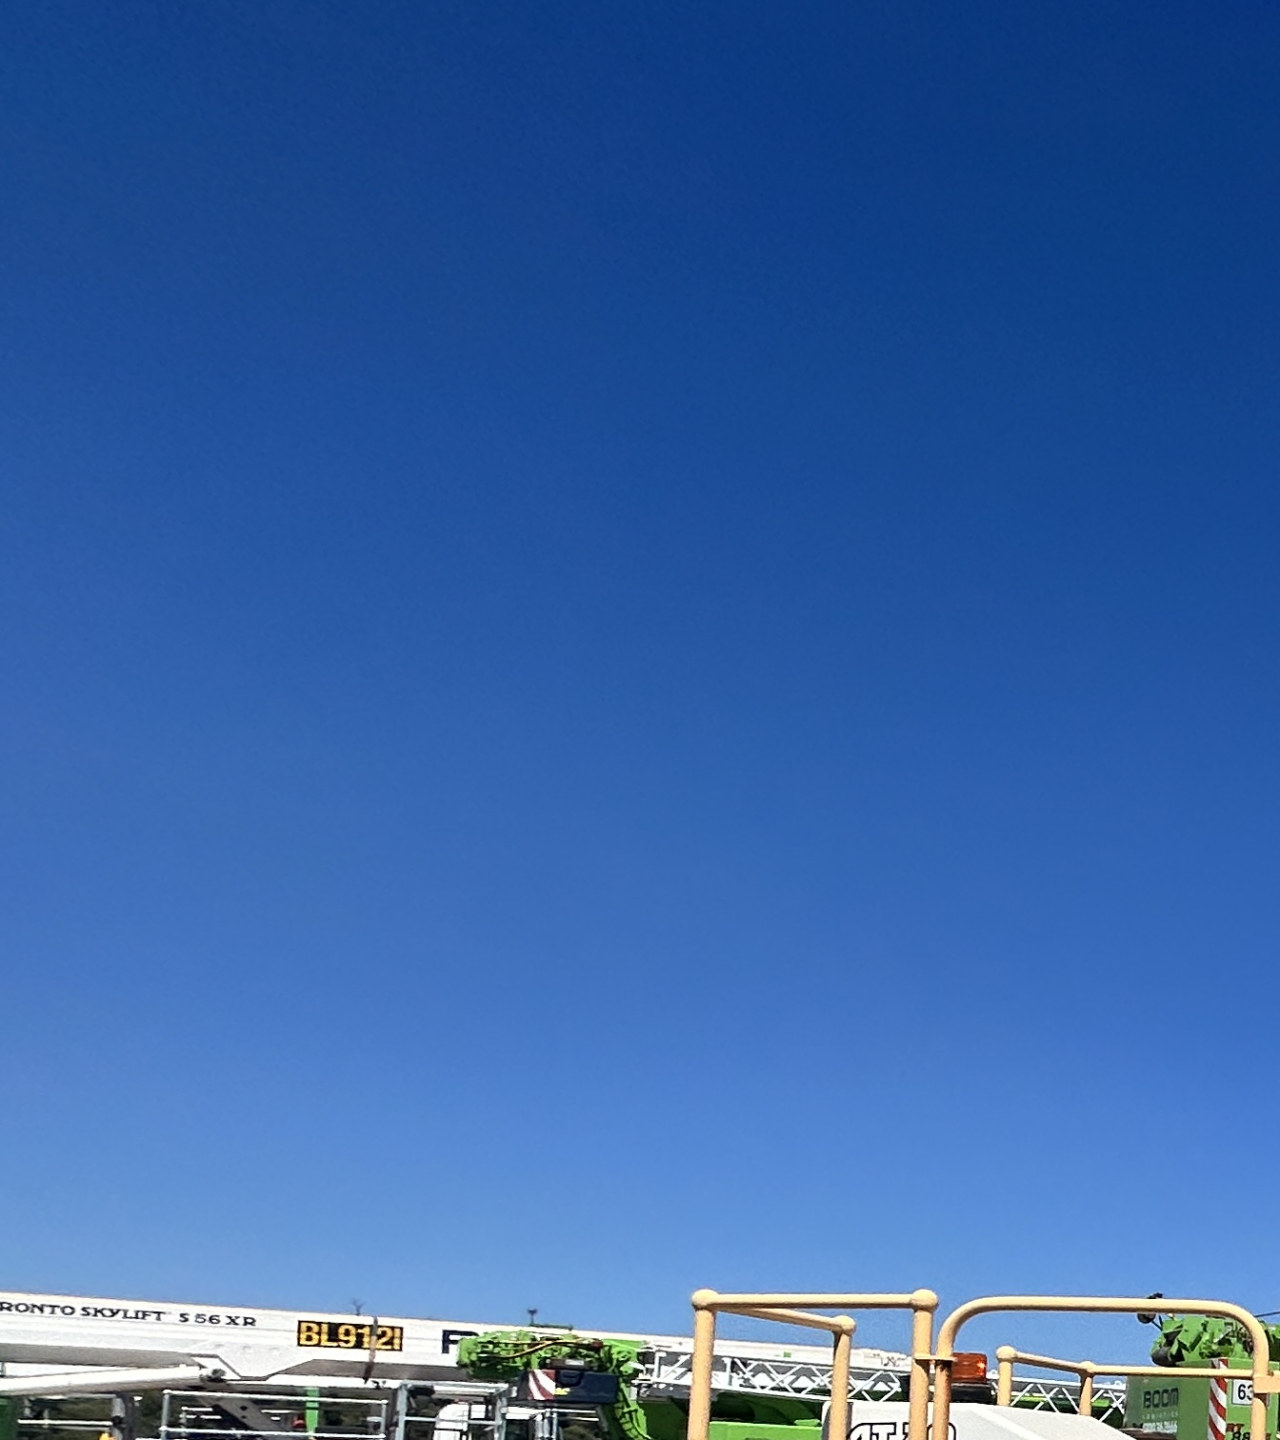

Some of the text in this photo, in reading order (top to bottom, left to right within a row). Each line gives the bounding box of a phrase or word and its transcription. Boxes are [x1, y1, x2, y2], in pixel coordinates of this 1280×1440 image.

[80, 1306, 166, 1321] SKYLIFT
[179, 1312, 190, 1323] S
[194, 1313, 221, 1325] 56
[1143, 1387, 1179, 1408] BOOM
